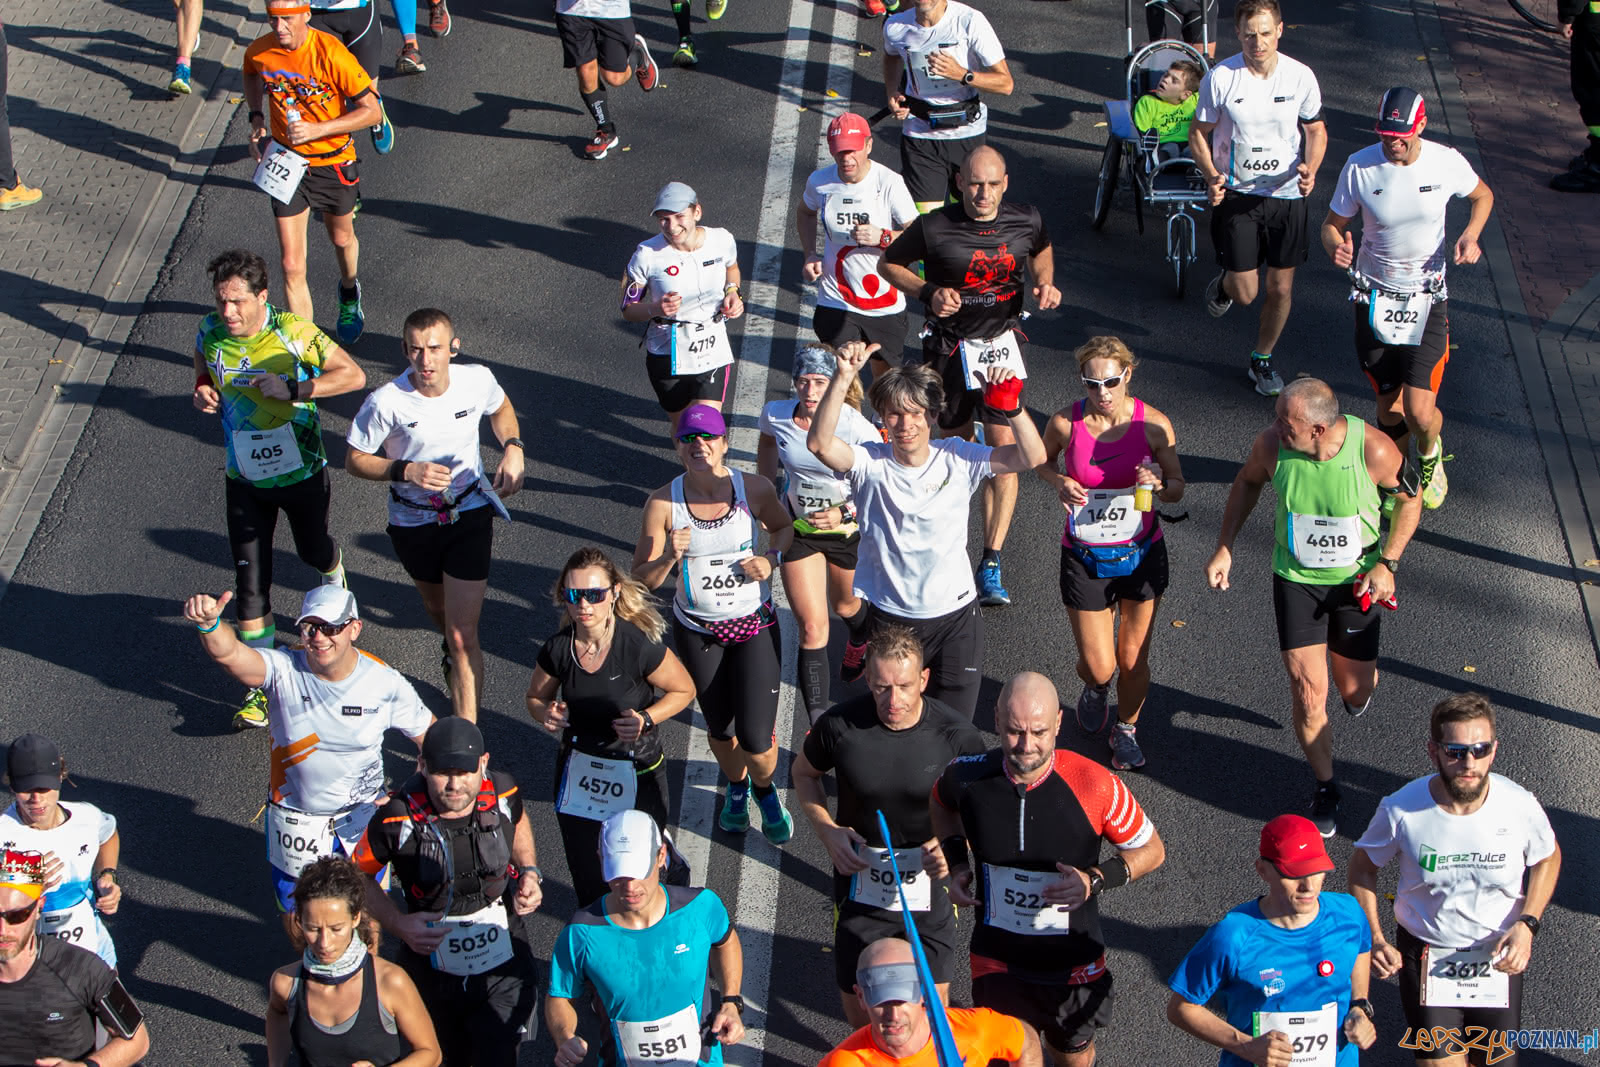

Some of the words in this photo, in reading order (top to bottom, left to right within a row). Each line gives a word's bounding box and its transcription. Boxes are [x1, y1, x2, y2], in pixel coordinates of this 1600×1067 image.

[265, 159, 290, 181] 2172
[1243, 159, 1279, 171] 4669
[1384, 309, 1419, 323] 2022
[689, 335, 716, 353] 4719
[978, 347, 1010, 364] 4599
[251, 444, 283, 460] 405
[1088, 508, 1127, 522] 1467
[1307, 534, 1348, 547] 4618
[702, 574, 746, 590] 2669
[579, 776, 623, 797] 4570
[276, 830, 319, 854] 1004
[449, 927, 498, 953] 5030
[1445, 961, 1491, 978] 3612
[638, 1034, 687, 1058] 5581
